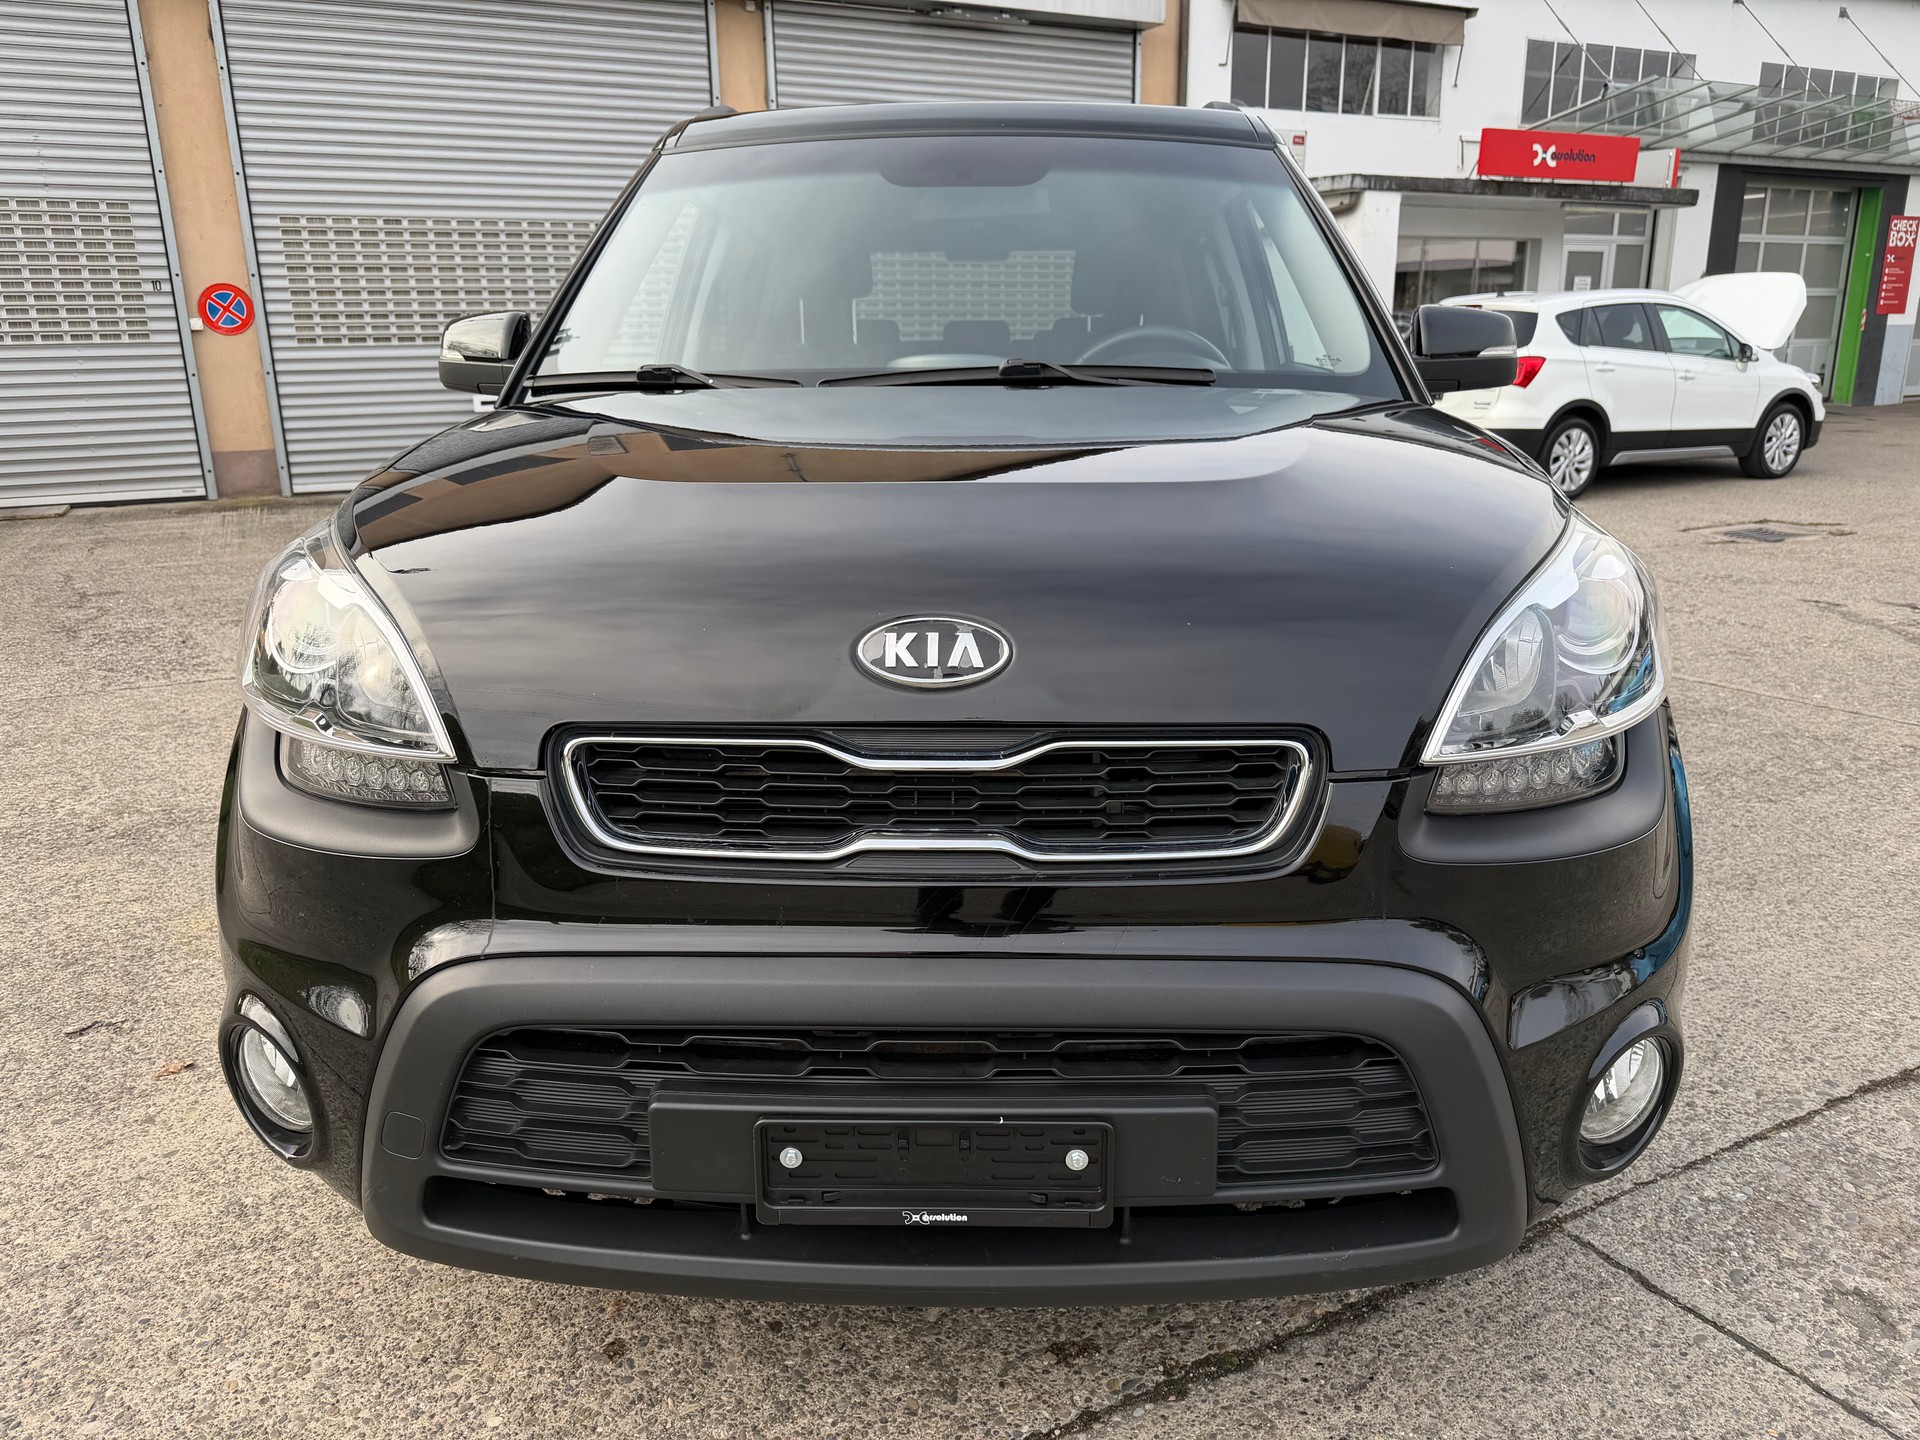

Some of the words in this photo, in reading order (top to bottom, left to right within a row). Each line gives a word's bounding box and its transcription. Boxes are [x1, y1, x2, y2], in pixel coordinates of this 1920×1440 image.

[1891, 219, 1919, 232] CHECK
[1889, 231, 1916, 247] BOX
[151, 280, 162, 292] 10
[884, 632, 985, 668] KIA
